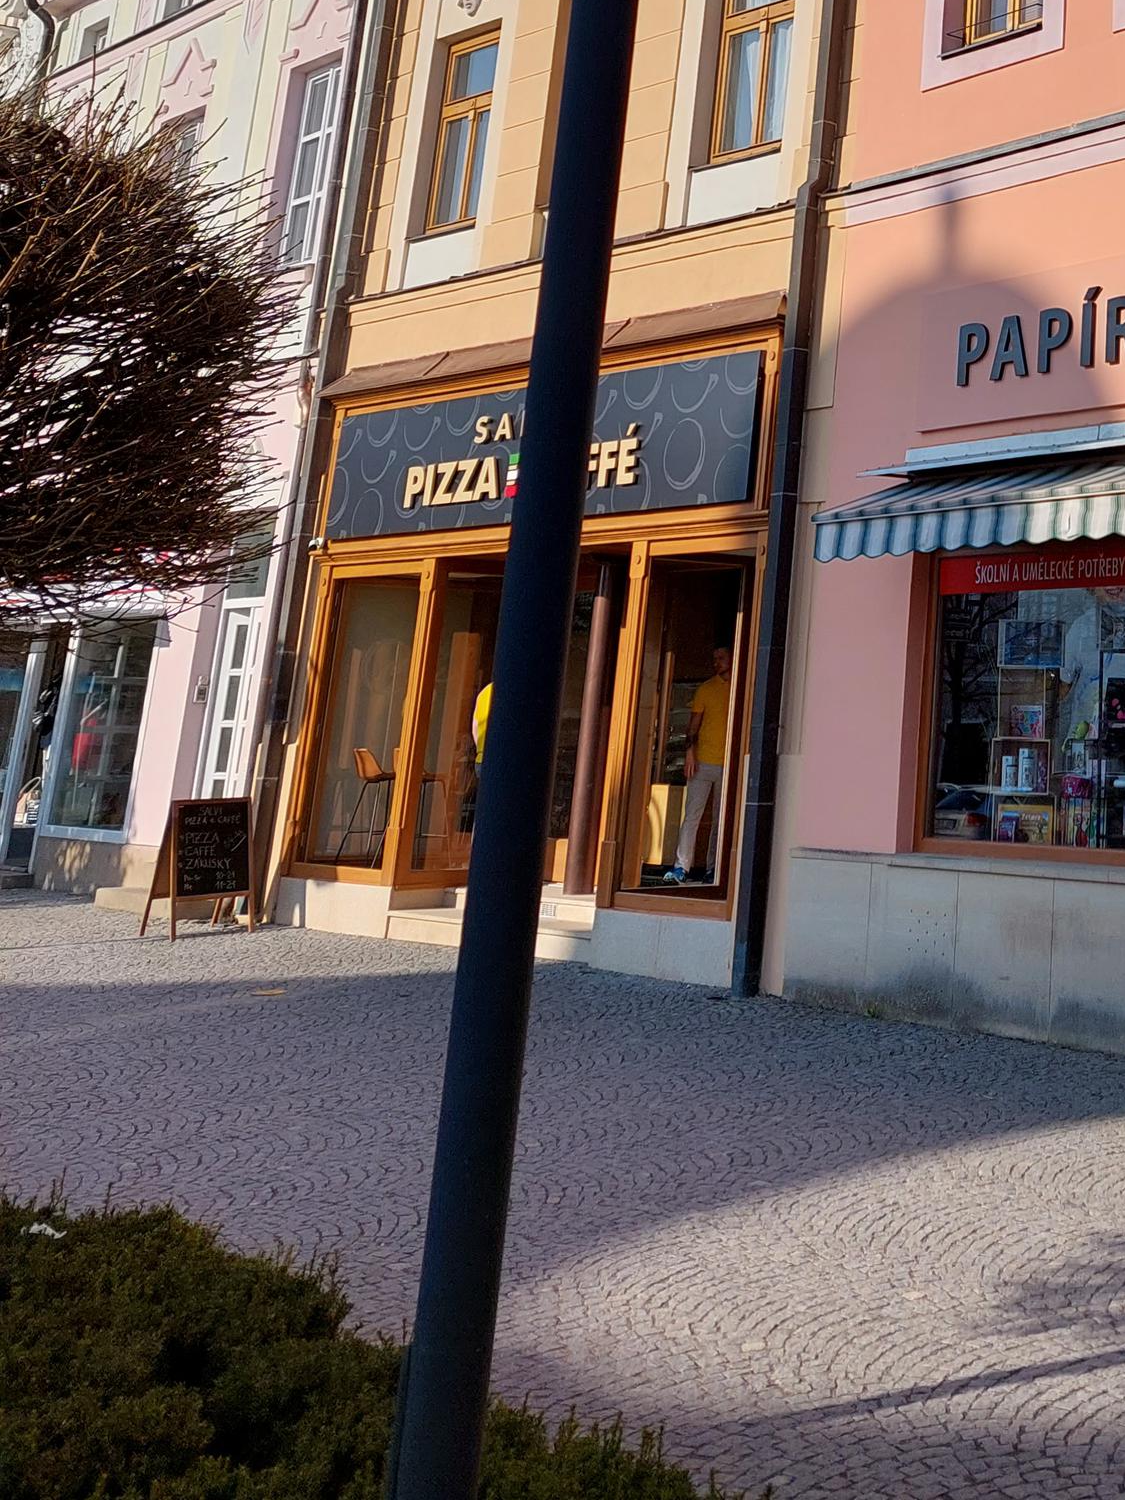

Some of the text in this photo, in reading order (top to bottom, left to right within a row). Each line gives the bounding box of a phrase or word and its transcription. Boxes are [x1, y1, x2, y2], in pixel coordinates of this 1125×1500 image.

[403, 456, 500, 509] PIZZA
[974, 552, 1125, 585] ŠKOLNÍ A UMĚLECKÉ POTŘEBY
[185, 831, 220, 844] PIZZA
